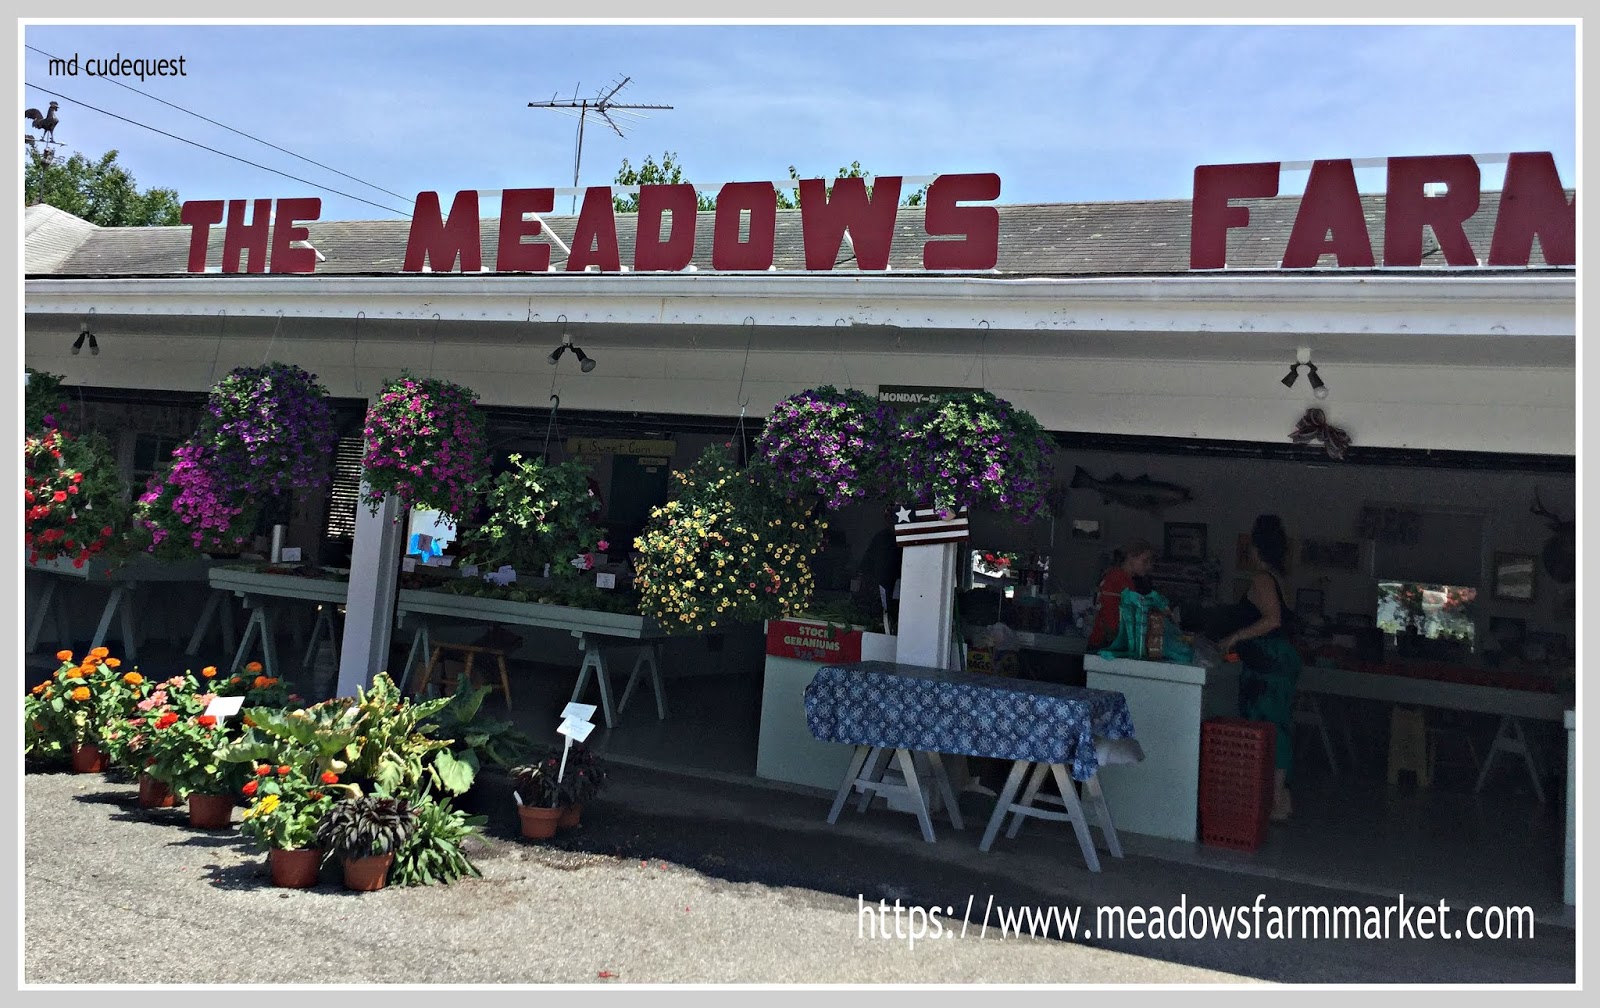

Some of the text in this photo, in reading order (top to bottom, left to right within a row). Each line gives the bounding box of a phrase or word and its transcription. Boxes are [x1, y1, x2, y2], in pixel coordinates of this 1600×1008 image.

[180, 197, 322, 272] THE
[403, 172, 1001, 271] MEADOWS
[589, 440, 652, 455] Sweet Corn
[783, 635, 841, 651] GERANIUMS
